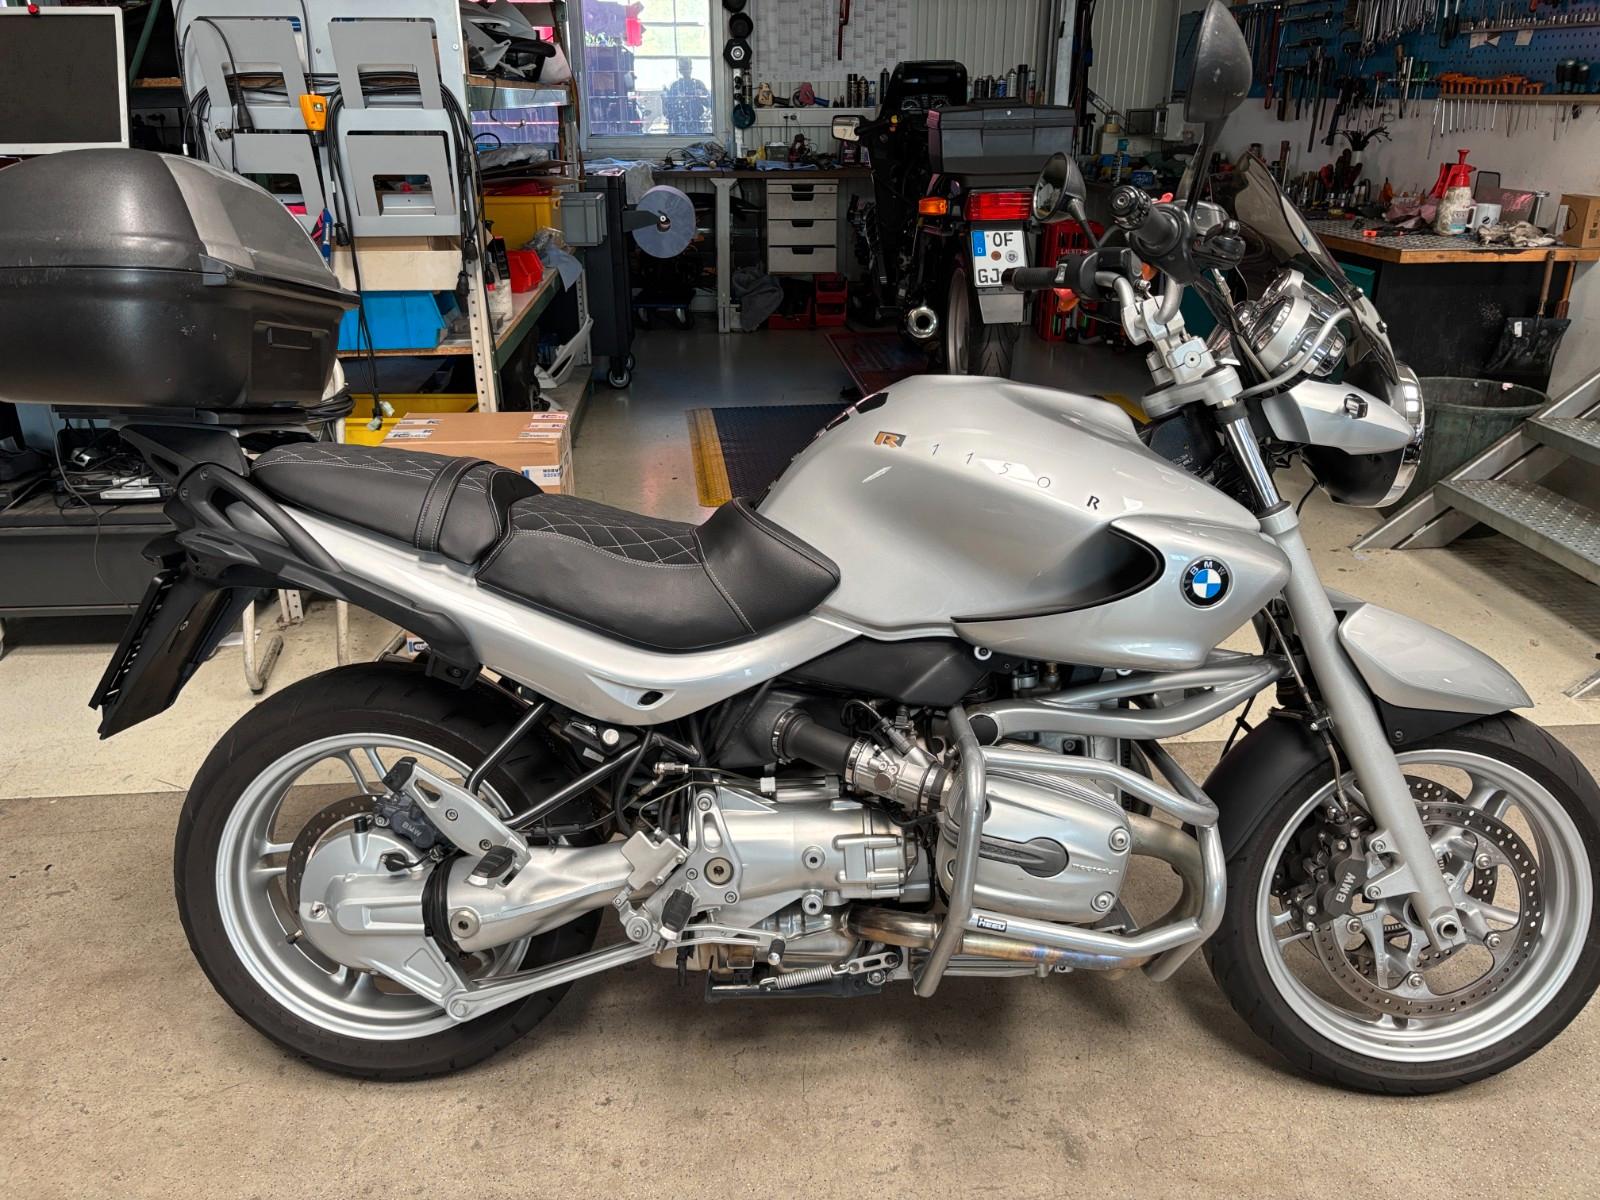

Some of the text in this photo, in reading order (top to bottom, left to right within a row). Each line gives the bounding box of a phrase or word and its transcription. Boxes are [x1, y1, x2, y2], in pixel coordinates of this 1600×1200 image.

[992, 232, 1013, 247] OF
[1086, 495, 1100, 511] R
[1190, 560, 1227, 577] BMW
[401, 821, 422, 837] BMW
[1335, 871, 1356, 903] BMW
